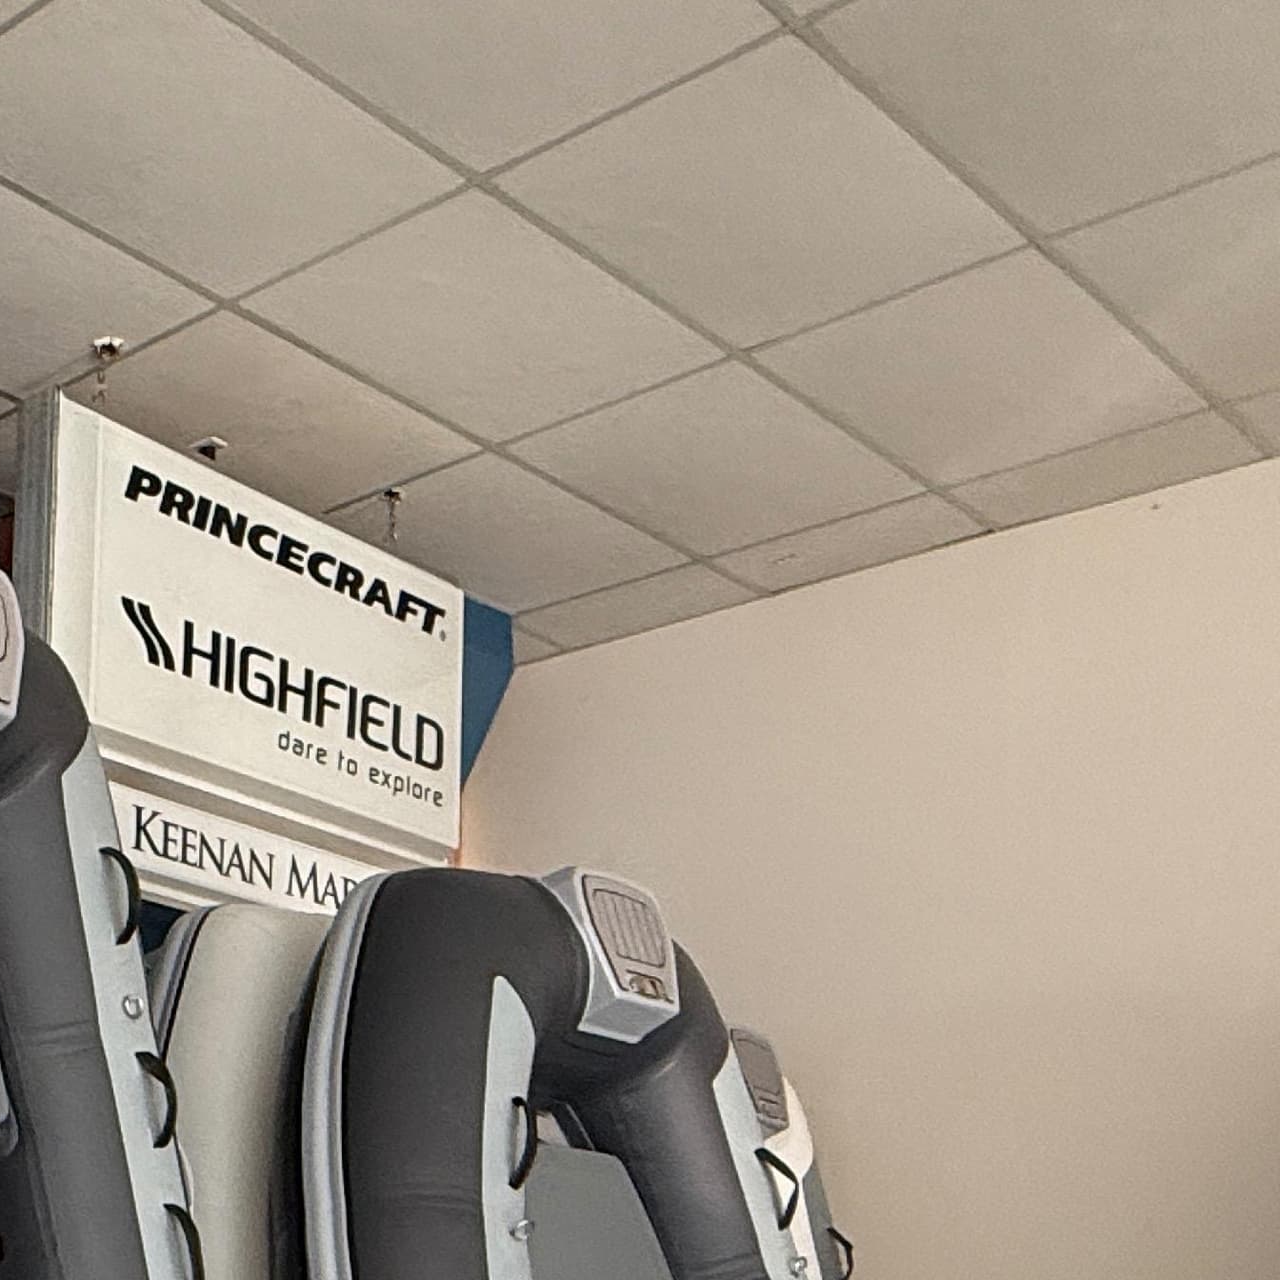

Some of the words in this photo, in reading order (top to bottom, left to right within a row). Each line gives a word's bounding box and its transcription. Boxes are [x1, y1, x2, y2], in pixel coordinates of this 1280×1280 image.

[124, 465, 446, 640] PRINCECRAFT
[182, 620, 444, 772] HIGHFIELD
[278, 730, 327, 766] dare
[337, 751, 358, 777] to
[368, 767, 444, 808] explore
[132, 804, 275, 891] KEENAN
